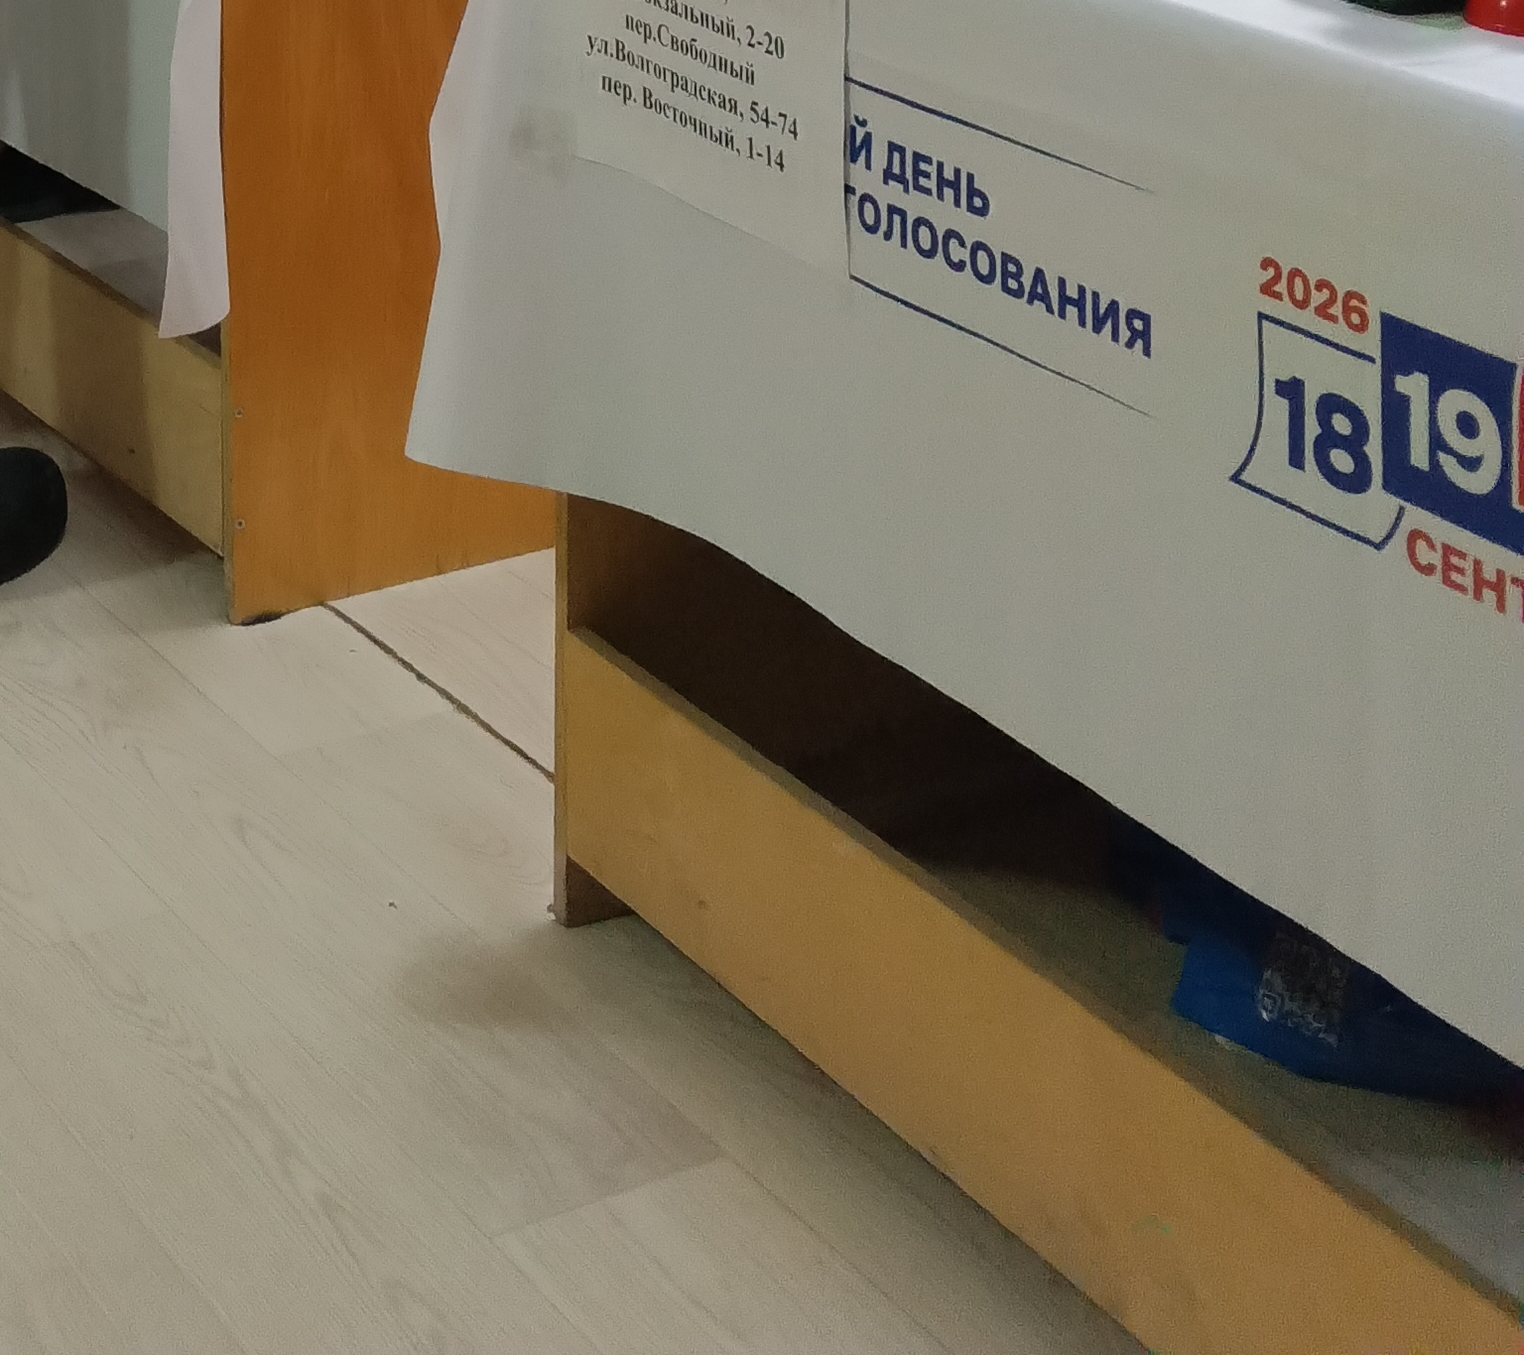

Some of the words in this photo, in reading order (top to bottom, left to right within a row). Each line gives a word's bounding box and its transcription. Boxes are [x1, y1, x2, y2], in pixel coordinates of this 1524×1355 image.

[625, 14, 756, 86] пер.Свободный
[746, 24, 785, 59] 2-20
[586, 34, 744, 123] ул.Волгоградская,
[749, 100, 799, 141] 54-74
[601, 74, 638, 107] пер.
[642, 86, 741, 158] Восточный,
[746, 136, 786, 172] 1-14
[882, 140, 991, 220] ДЕНЬ
[1259, 256, 1370, 334] 2026
[1275, 375, 1373, 495] 18
[1394, 372, 1503, 495] 19
